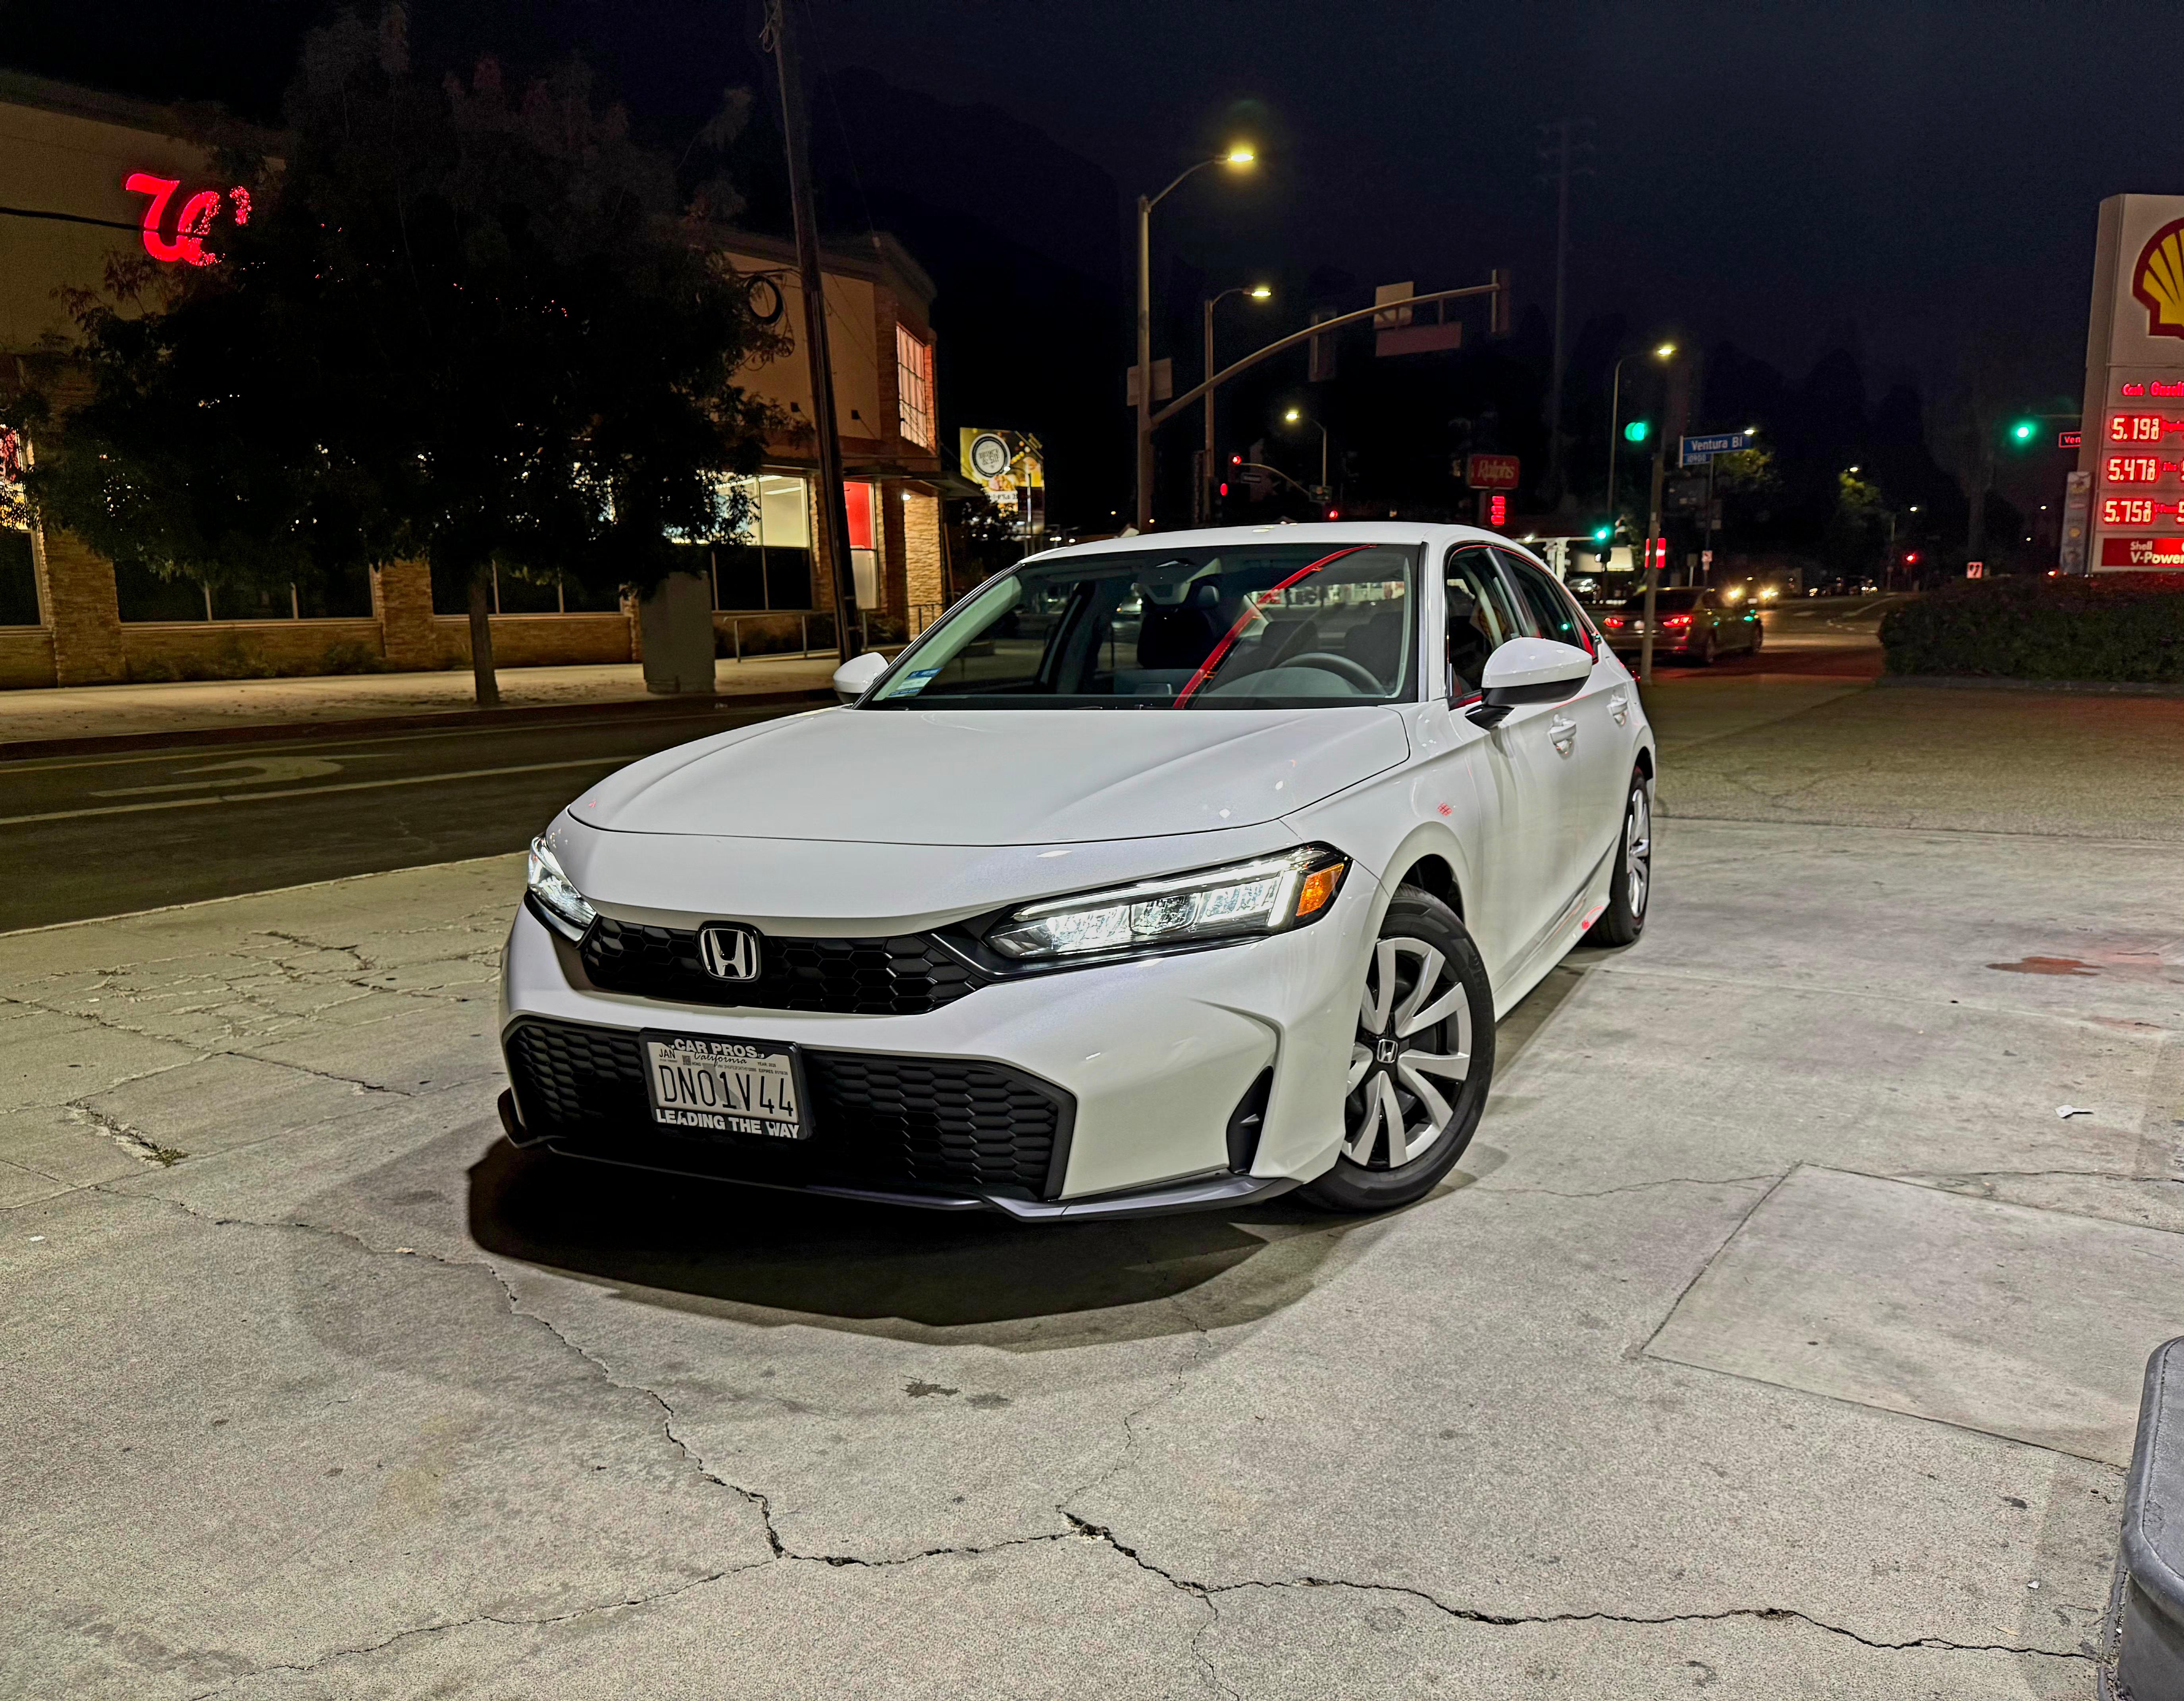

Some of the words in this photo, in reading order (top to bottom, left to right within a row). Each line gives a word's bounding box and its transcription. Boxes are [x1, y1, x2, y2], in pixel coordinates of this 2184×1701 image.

[1691, 439, 1728, 451] Ventura
[2130, 540, 2153, 551] Shell
[659, 1048, 676, 1059] JAN
[674, 1038, 708, 1055] CAR
[694, 1051, 747, 1067] California
[656, 1109, 726, 1130] LEADING
[728, 1117, 762, 1135] THE
[765, 1121, 799, 1139] WAY
